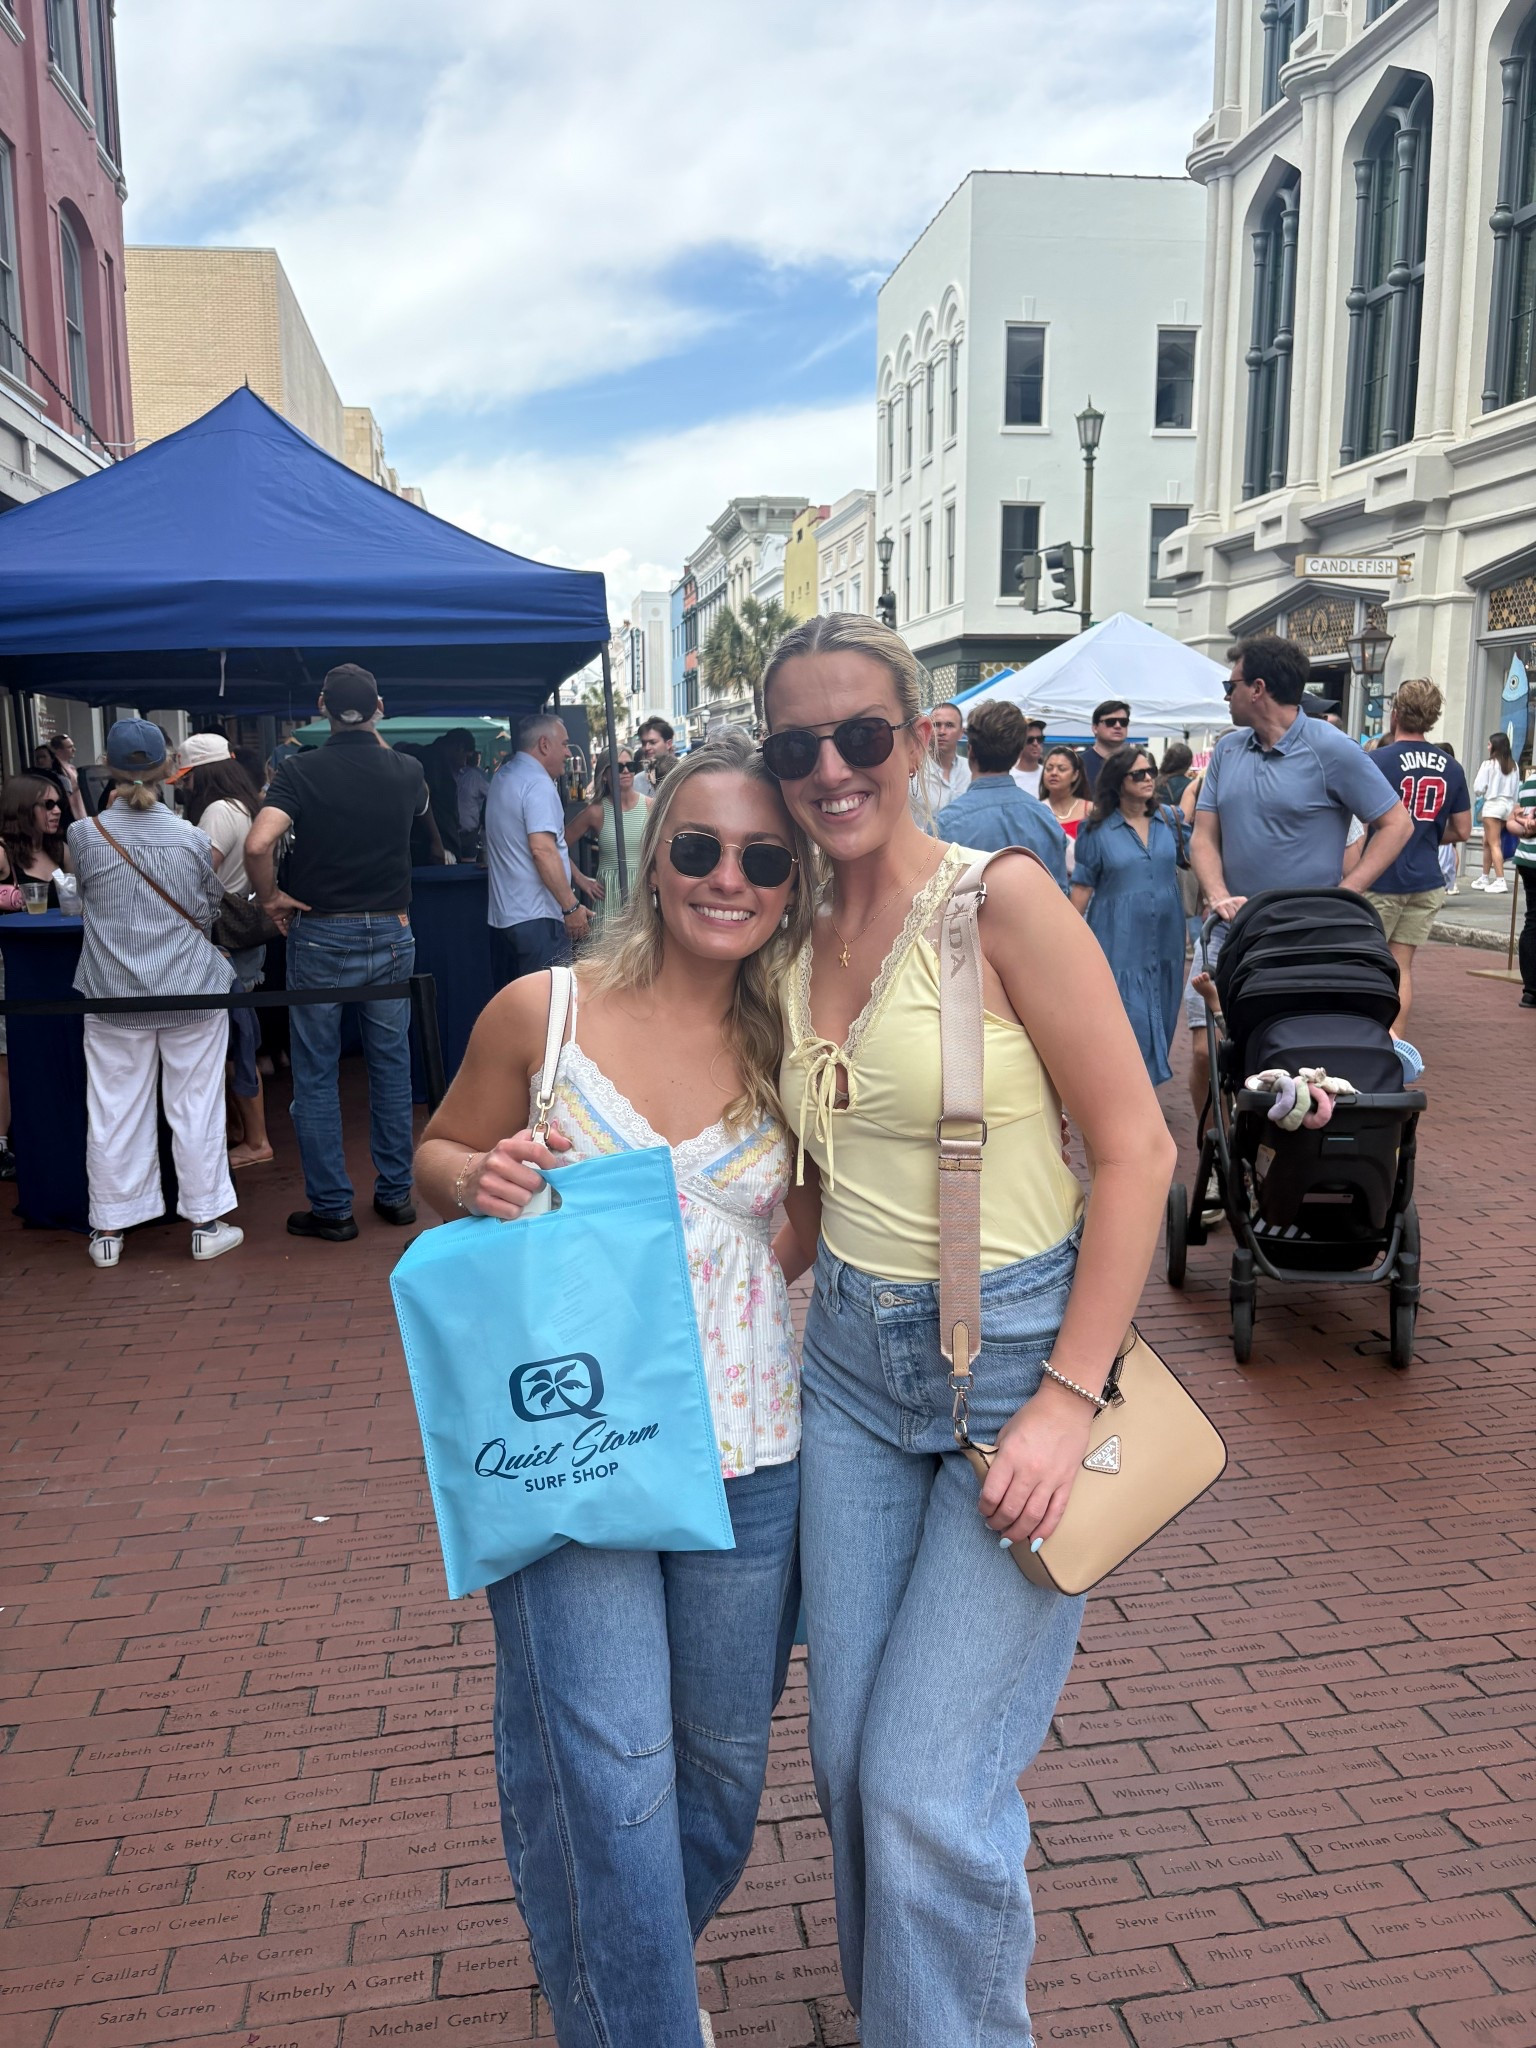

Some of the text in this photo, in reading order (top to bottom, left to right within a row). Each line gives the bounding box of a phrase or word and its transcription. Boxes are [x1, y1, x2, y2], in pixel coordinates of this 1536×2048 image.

[1310, 560, 1393, 574] CANDLEFISH
[1400, 752, 1448, 772] JONES
[1400, 776, 1446, 822] 10
[474, 1420, 660, 1480] Quiet Storm
[1092, 1444, 1115, 1464] PRADA
[524, 1462, 619, 1493] SURF SHOP
[356, 1634, 420, 1648] Jim Gilday
[1180, 1642, 1266, 1660] Joseph Griffith
[223, 1656, 234, 1664] D
[403, 1654, 456, 1666] Matthew
[1088, 1656, 1135, 1669] Griffith
[1256, 1658, 1361, 1679] Elizabeth Griffith
[268, 1670, 314, 1681] Thelma
[1127, 1676, 1226, 1695] Stephen Griffith
[1474, 1670, 1521, 1682] Norbert
[328, 1692, 360, 1701] Brian
[1392, 1686, 1400, 1696] P
[1404, 1682, 1460, 1693] Goodwin
[392, 1712, 418, 1722] Sara
[465, 1705, 475, 1713] D
[1213, 1704, 1259, 1716] George
[1273, 1695, 1322, 1709] Griffith
[1448, 1706, 1501, 1720] Helen Z
[1078, 1714, 1176, 1732] Alice S Griffith
[1306, 1718, 1410, 1740] Stephan Gerlach
[88, 1739, 215, 1761] Elizabeth Gilreath
[1170, 1736, 1274, 1755] Michael Gerken
[1402, 1739, 1514, 1763] Clara H Grimball
[168, 1760, 280, 1783] Harry M Given
[390, 1768, 467, 1786] Elizabeth K
[1033, 1762, 1064, 1774] John
[1112, 1778, 1225, 1800] Whitney Gilliam
[1368, 1784, 1474, 1806] Irene V Godsey
[1042, 1796, 1086, 1810] Gilliam
[74, 1807, 183, 1828] Eva L Goolsby
[296, 1809, 436, 1833] Ethel Meyer Glover
[1204, 1803, 1319, 1828] Ernest B Godsey
[1468, 1813, 1534, 1831] Charles S
[122, 1830, 273, 1857] Dick & Betty Grant
[408, 1834, 498, 1856] Ned Grimke
[1045, 1822, 1188, 1848] Katherine R Godsey
[1309, 1826, 1448, 1856] D Christian Goodall
[226, 1860, 331, 1883] Roy Greenlee
[1159, 1850, 1285, 1876] Linell M Goodall
[1437, 1864, 1473, 1880] Sally
[137, 1880, 179, 1894] Grant
[744, 1878, 788, 1892] Roger
[1036, 1875, 1120, 1894] A Gourdine
[1276, 1879, 1386, 1904] Shelley Griffin
[362, 1886, 422, 1904] Griffith
[118, 1912, 240, 1937] Carol Greenlee
[456, 1915, 510, 1932] Groves
[1114, 1906, 1218, 1931] Stevie Griffin
[1371, 1923, 1412, 1936] Irene
[1415, 1916, 1428, 1929] S
[704, 1924, 776, 1943] Gwynette
[216, 1946, 314, 1964] Abe Garren
[1208, 1931, 1333, 1963] Philip Garfinkel
[91, 1963, 159, 1984] Gaillard
[457, 1956, 520, 1973] Herbert
[256, 1970, 425, 2004] Kimberly A Garrett
[735, 1970, 786, 1989] John &
[1025, 1960, 1163, 1994] Elyse S Garfinkel
[1323, 1963, 1475, 1997] P Nicholas Gaspers
[98, 2002, 215, 2026] Sarah Garren
[1140, 1992, 1292, 2026] Betty Jean Gaspers
[368, 2010, 510, 2038] Michael Gentry
[1050, 2021, 1114, 2040] Gaspers
[1460, 2010, 1529, 2034] Mildred
[1354, 2024, 1418, 2048] Cement
